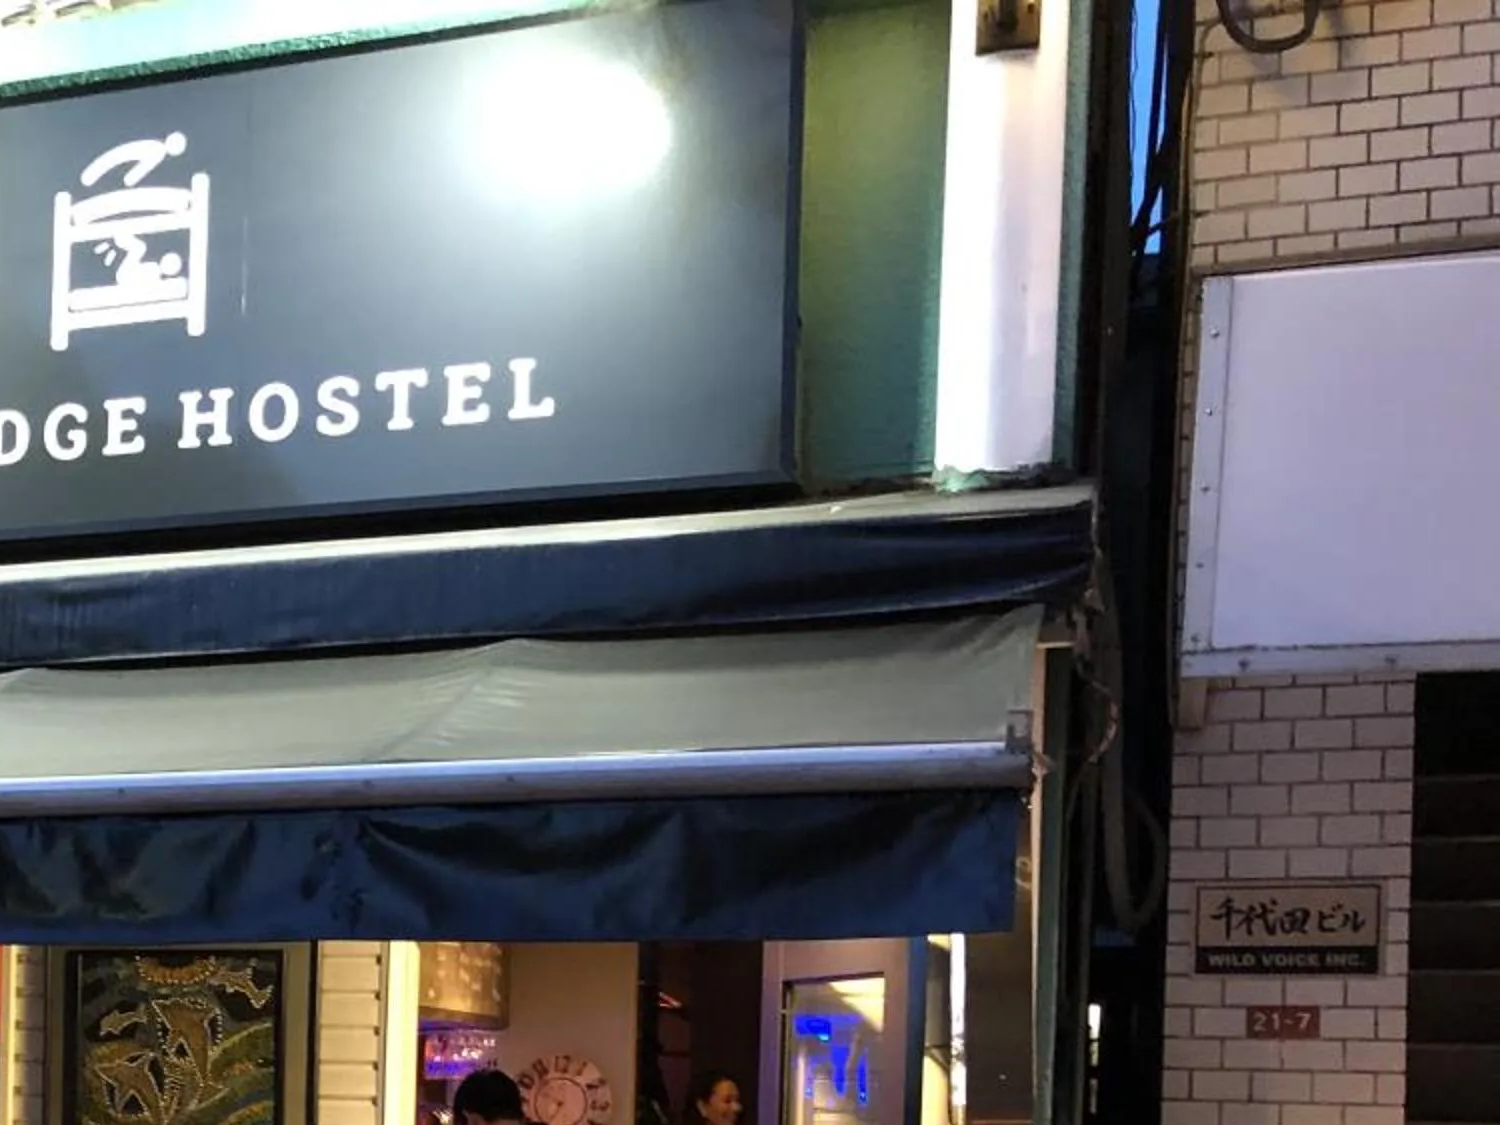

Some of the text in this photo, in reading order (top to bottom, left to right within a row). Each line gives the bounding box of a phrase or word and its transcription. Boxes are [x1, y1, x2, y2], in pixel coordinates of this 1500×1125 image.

[177, 356, 556, 450] HOSTEL
[1209, 896, 1366, 941] 千代田ビル
[1208, 953, 1256, 968] WILD
[1262, 953, 1321, 967] VOICE
[1251, 1012, 1312, 1031] 21-7
